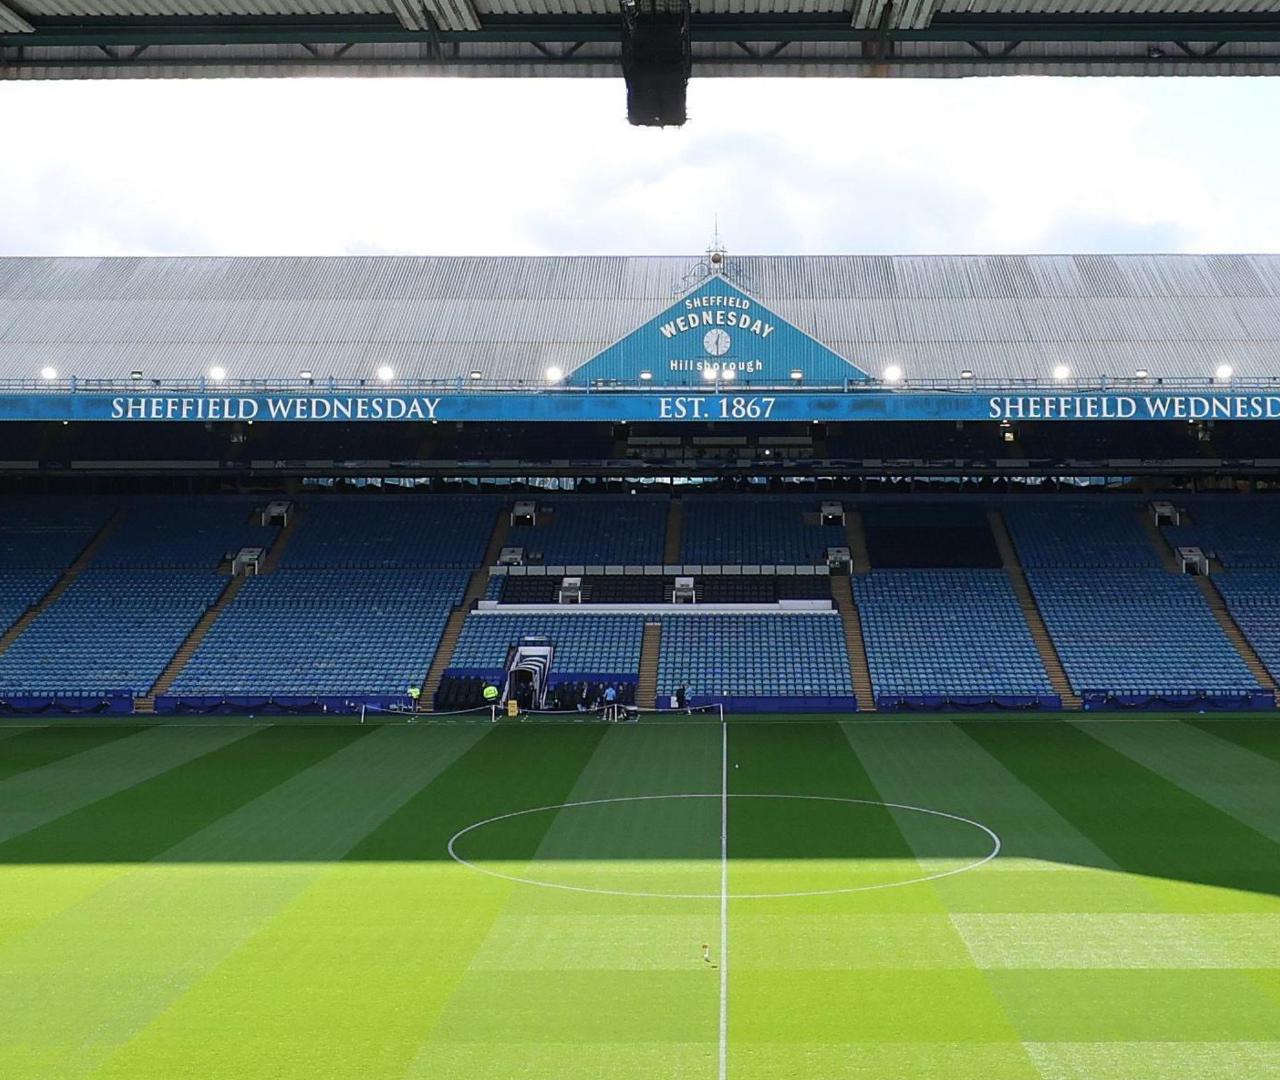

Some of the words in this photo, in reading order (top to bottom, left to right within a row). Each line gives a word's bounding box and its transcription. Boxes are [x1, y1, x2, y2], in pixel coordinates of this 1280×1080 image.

[685, 295, 750, 310] SHEFFIELD
[660, 310, 774, 338] WEDNESDAY
[670, 359, 763, 373] Hillsborough
[111, 397, 259, 419] SHEFFIELD
[267, 398, 442, 419] WEDNESDAY
[659, 397, 709, 418] EST.
[718, 397, 776, 418] 1867
[989, 397, 1137, 419] SHEFFIELD
